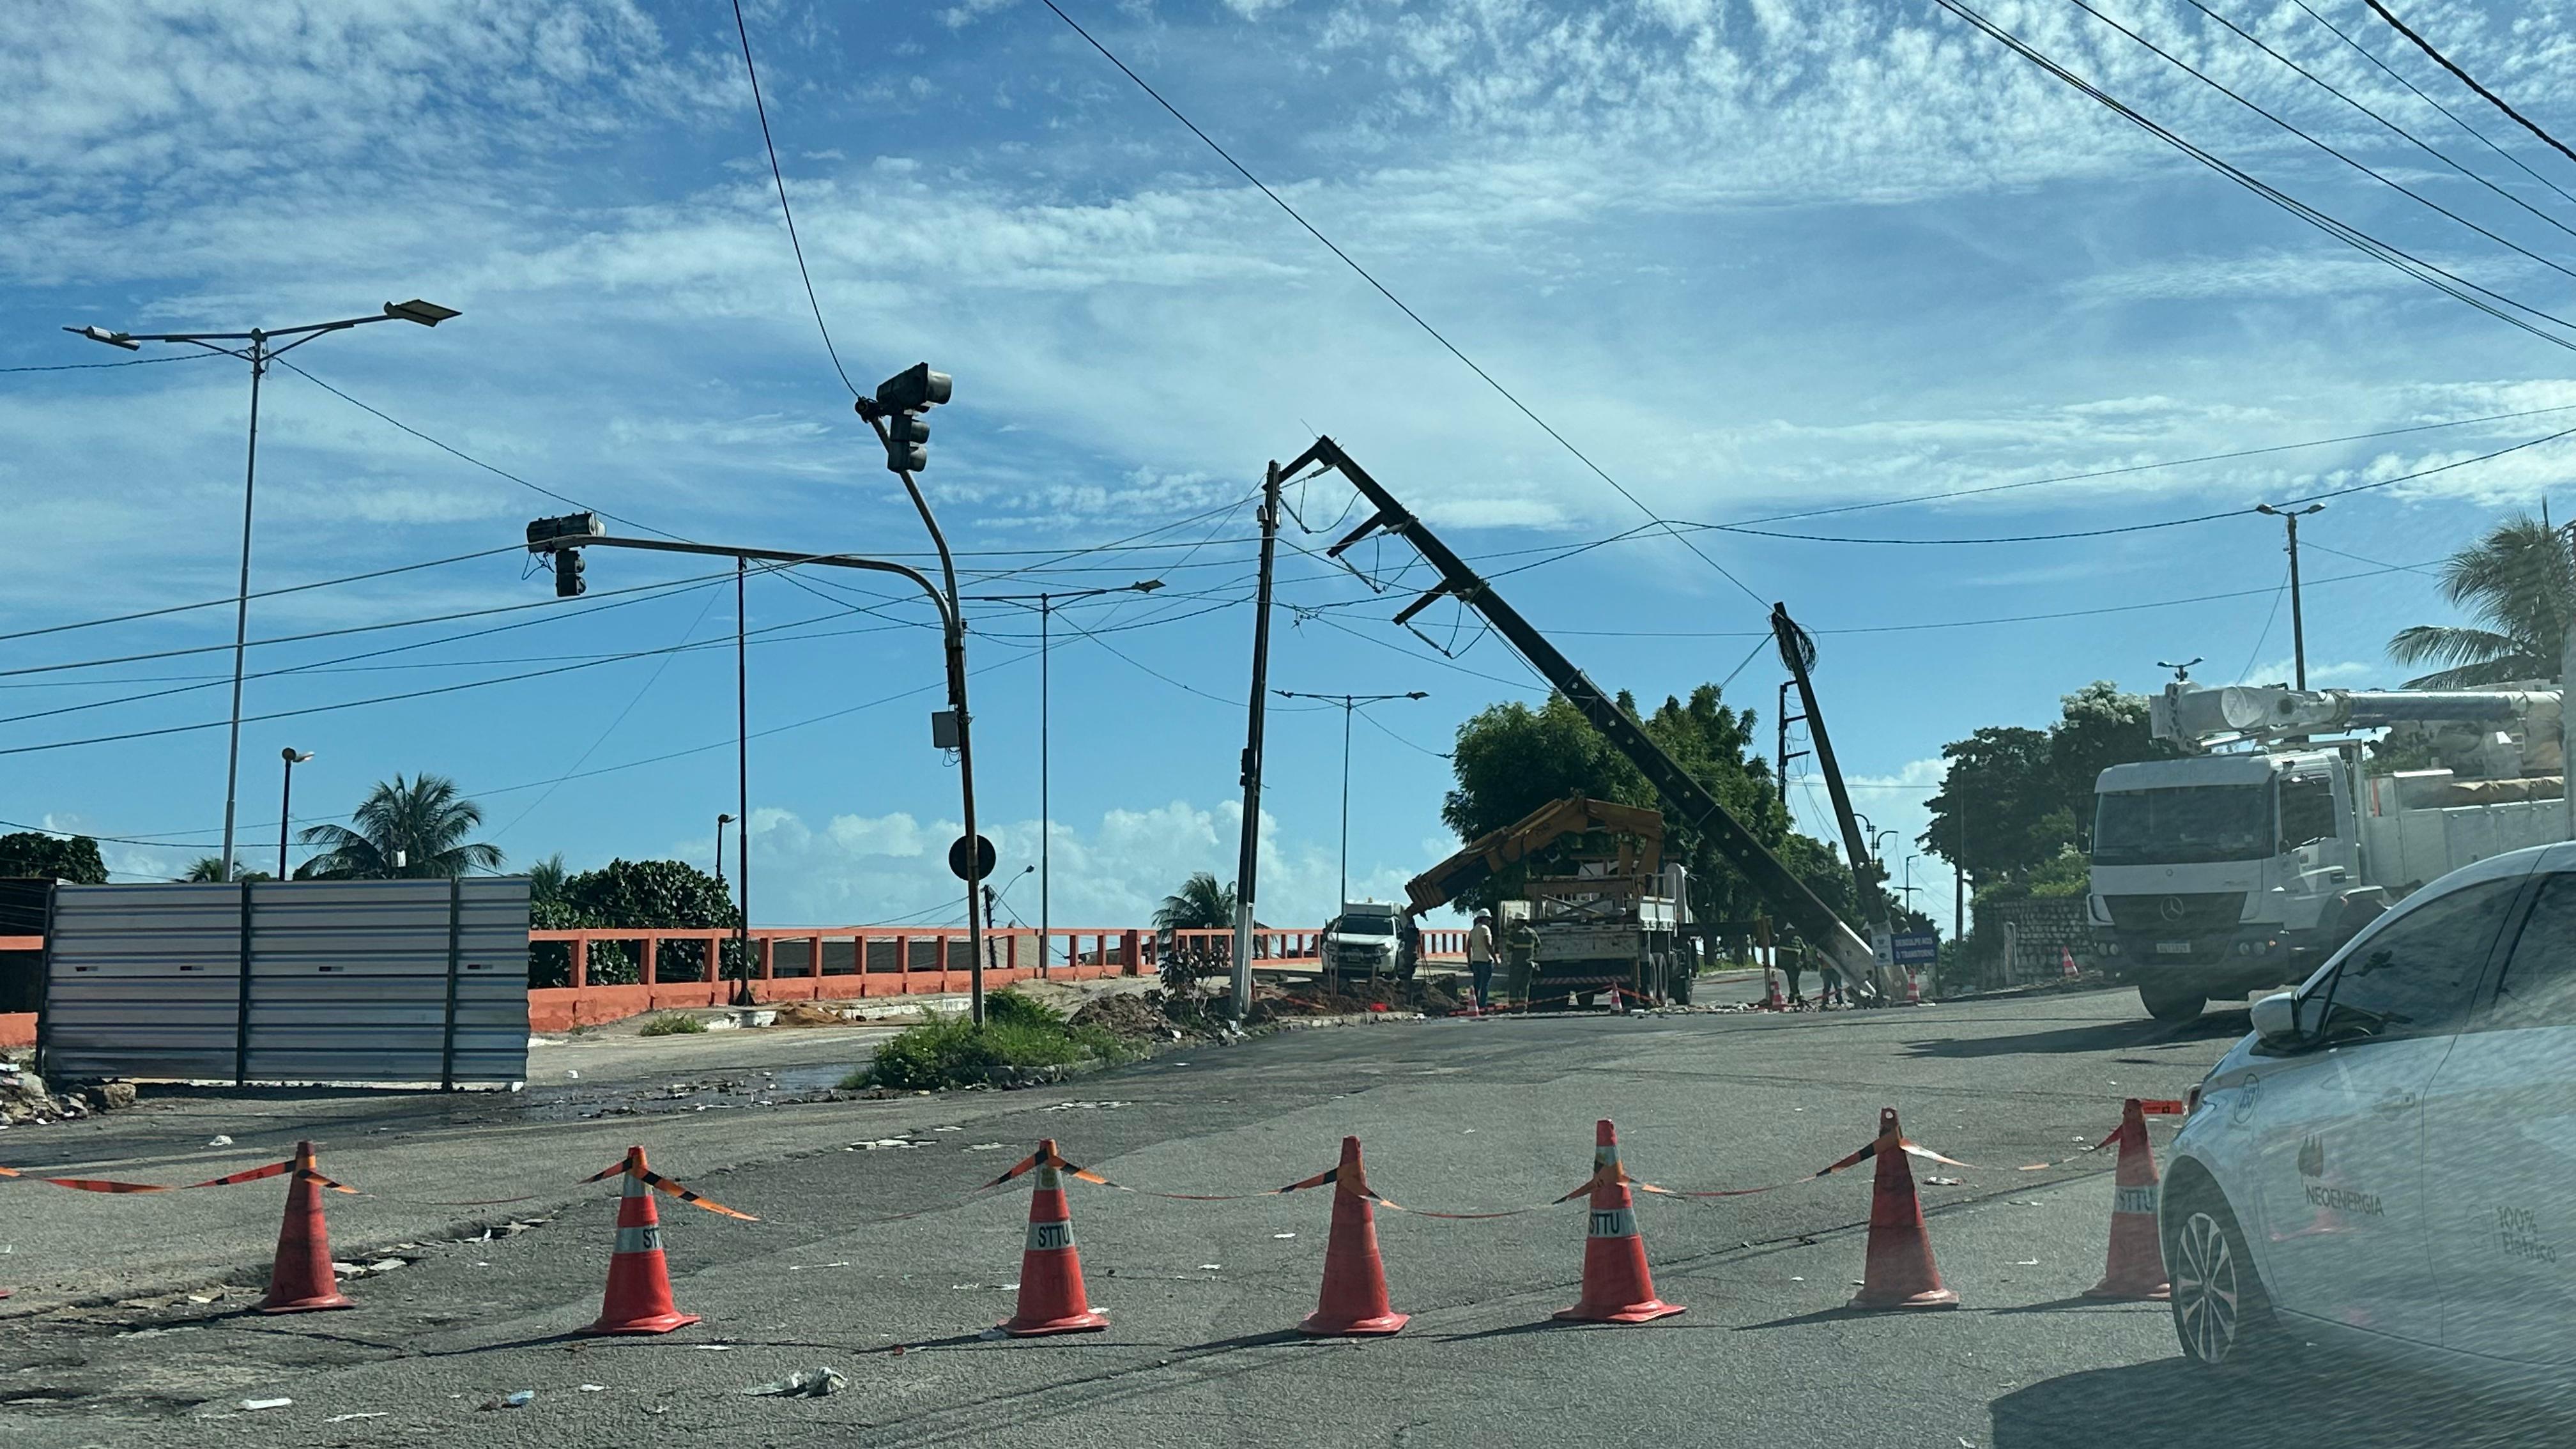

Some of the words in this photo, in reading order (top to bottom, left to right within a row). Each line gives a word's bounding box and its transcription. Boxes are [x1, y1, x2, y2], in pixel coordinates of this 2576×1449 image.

[2119, 1189, 2153, 1211] STTU
[2306, 1184, 2385, 1216] NEOENERGIA
[1589, 1211, 1620, 1234] STTU
[2497, 1206, 2538, 1234] 100%
[1038, 1224, 1070, 1247] STTU
